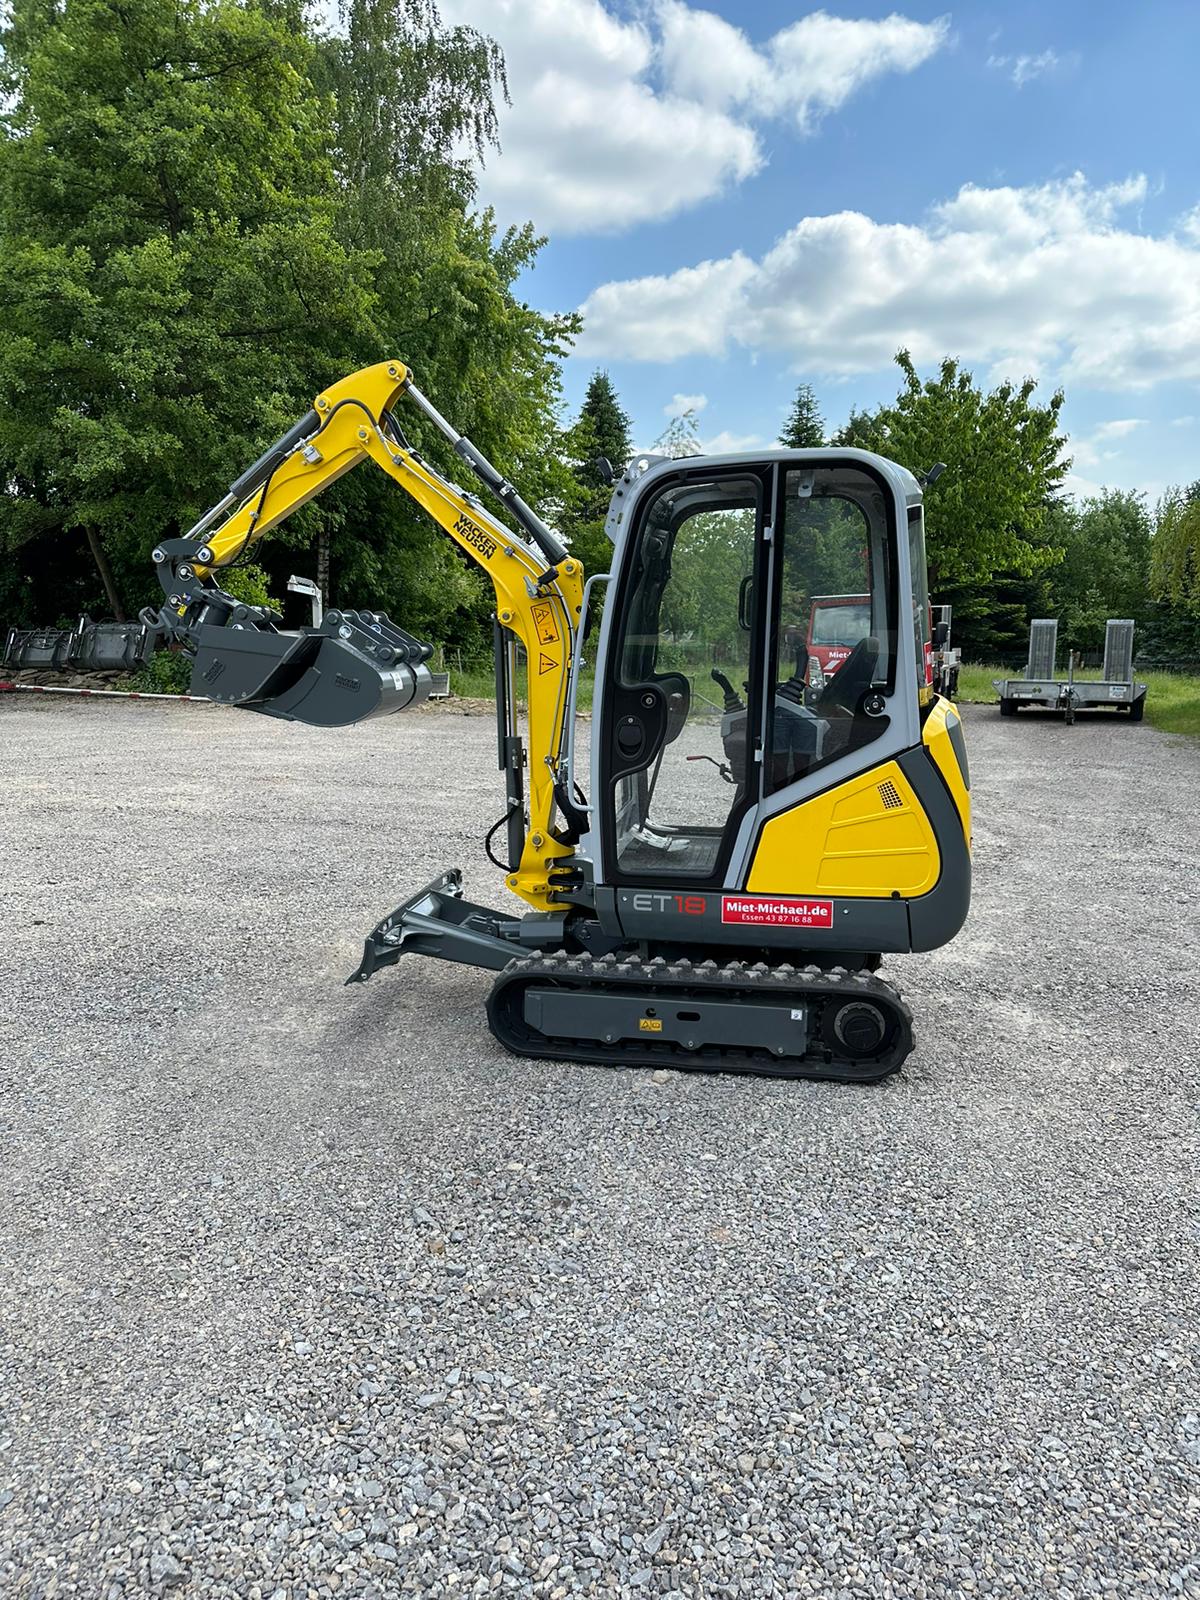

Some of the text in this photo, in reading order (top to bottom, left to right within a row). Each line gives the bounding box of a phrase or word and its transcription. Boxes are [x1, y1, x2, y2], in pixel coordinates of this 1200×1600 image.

[453, 521, 493, 560] NEUSON
[459, 513, 497, 553] WACKER
[828, 651, 852, 659] Miet-
[726, 902, 828, 917] Miet-Michael.de
[741, 914, 764, 922] Essen
[777, 915, 789, 923] 87
